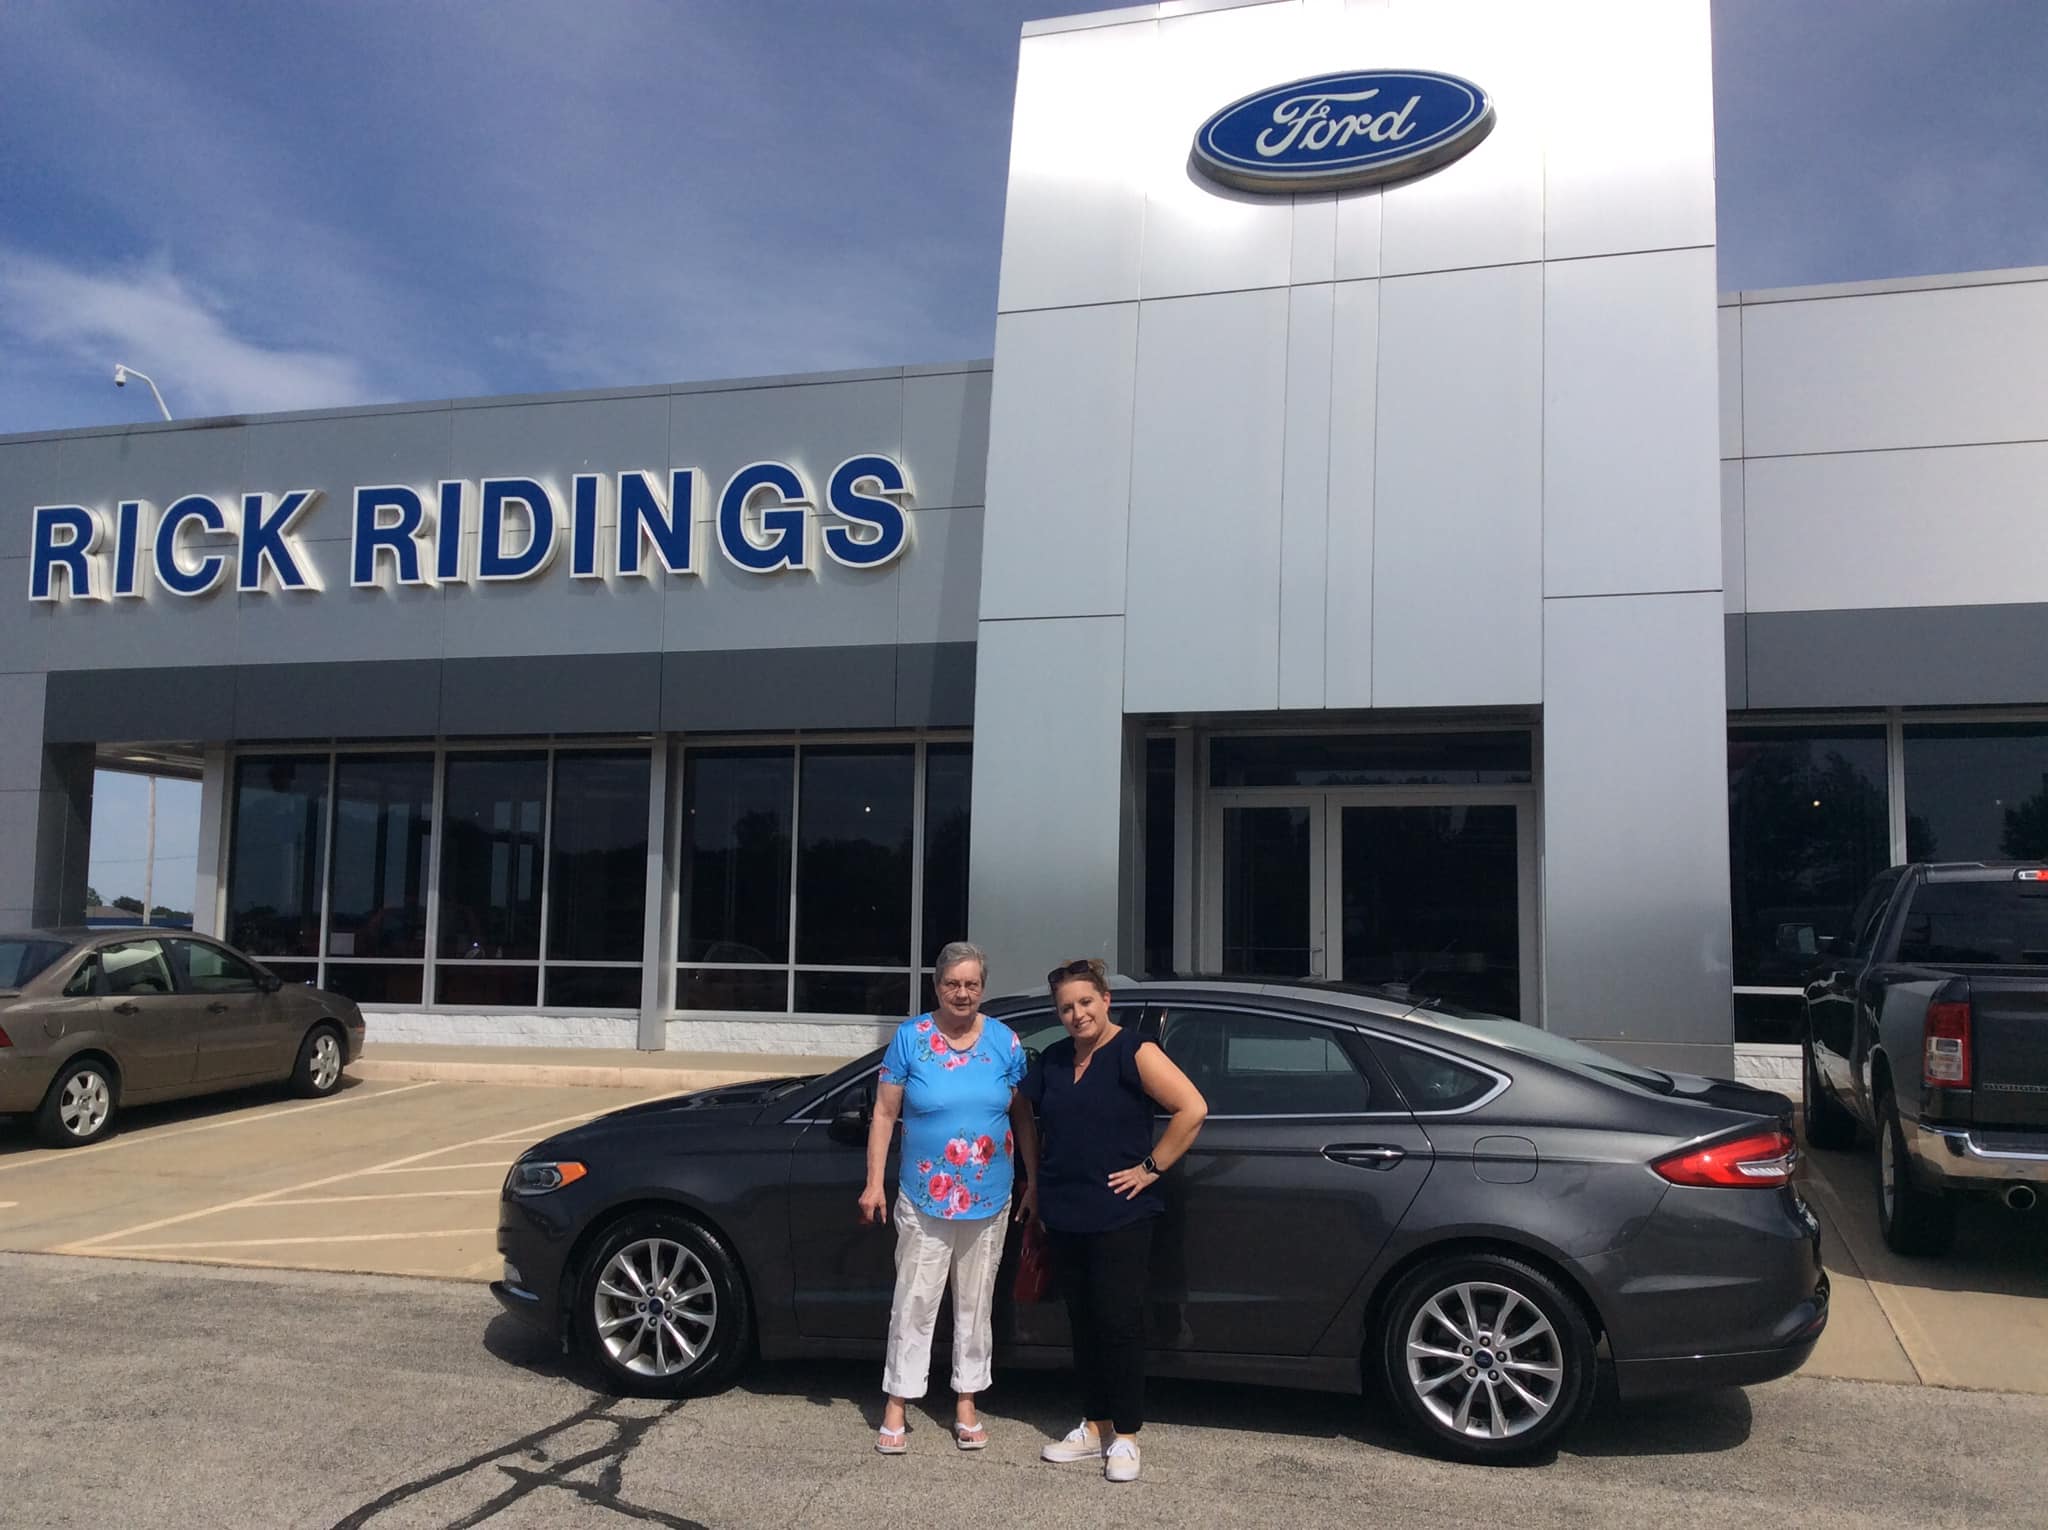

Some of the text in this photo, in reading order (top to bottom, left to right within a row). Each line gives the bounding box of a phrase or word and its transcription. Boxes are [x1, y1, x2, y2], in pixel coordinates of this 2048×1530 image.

[1256, 88, 1421, 157] Ford
[29, 455, 910, 600] RICK RIDINGS
